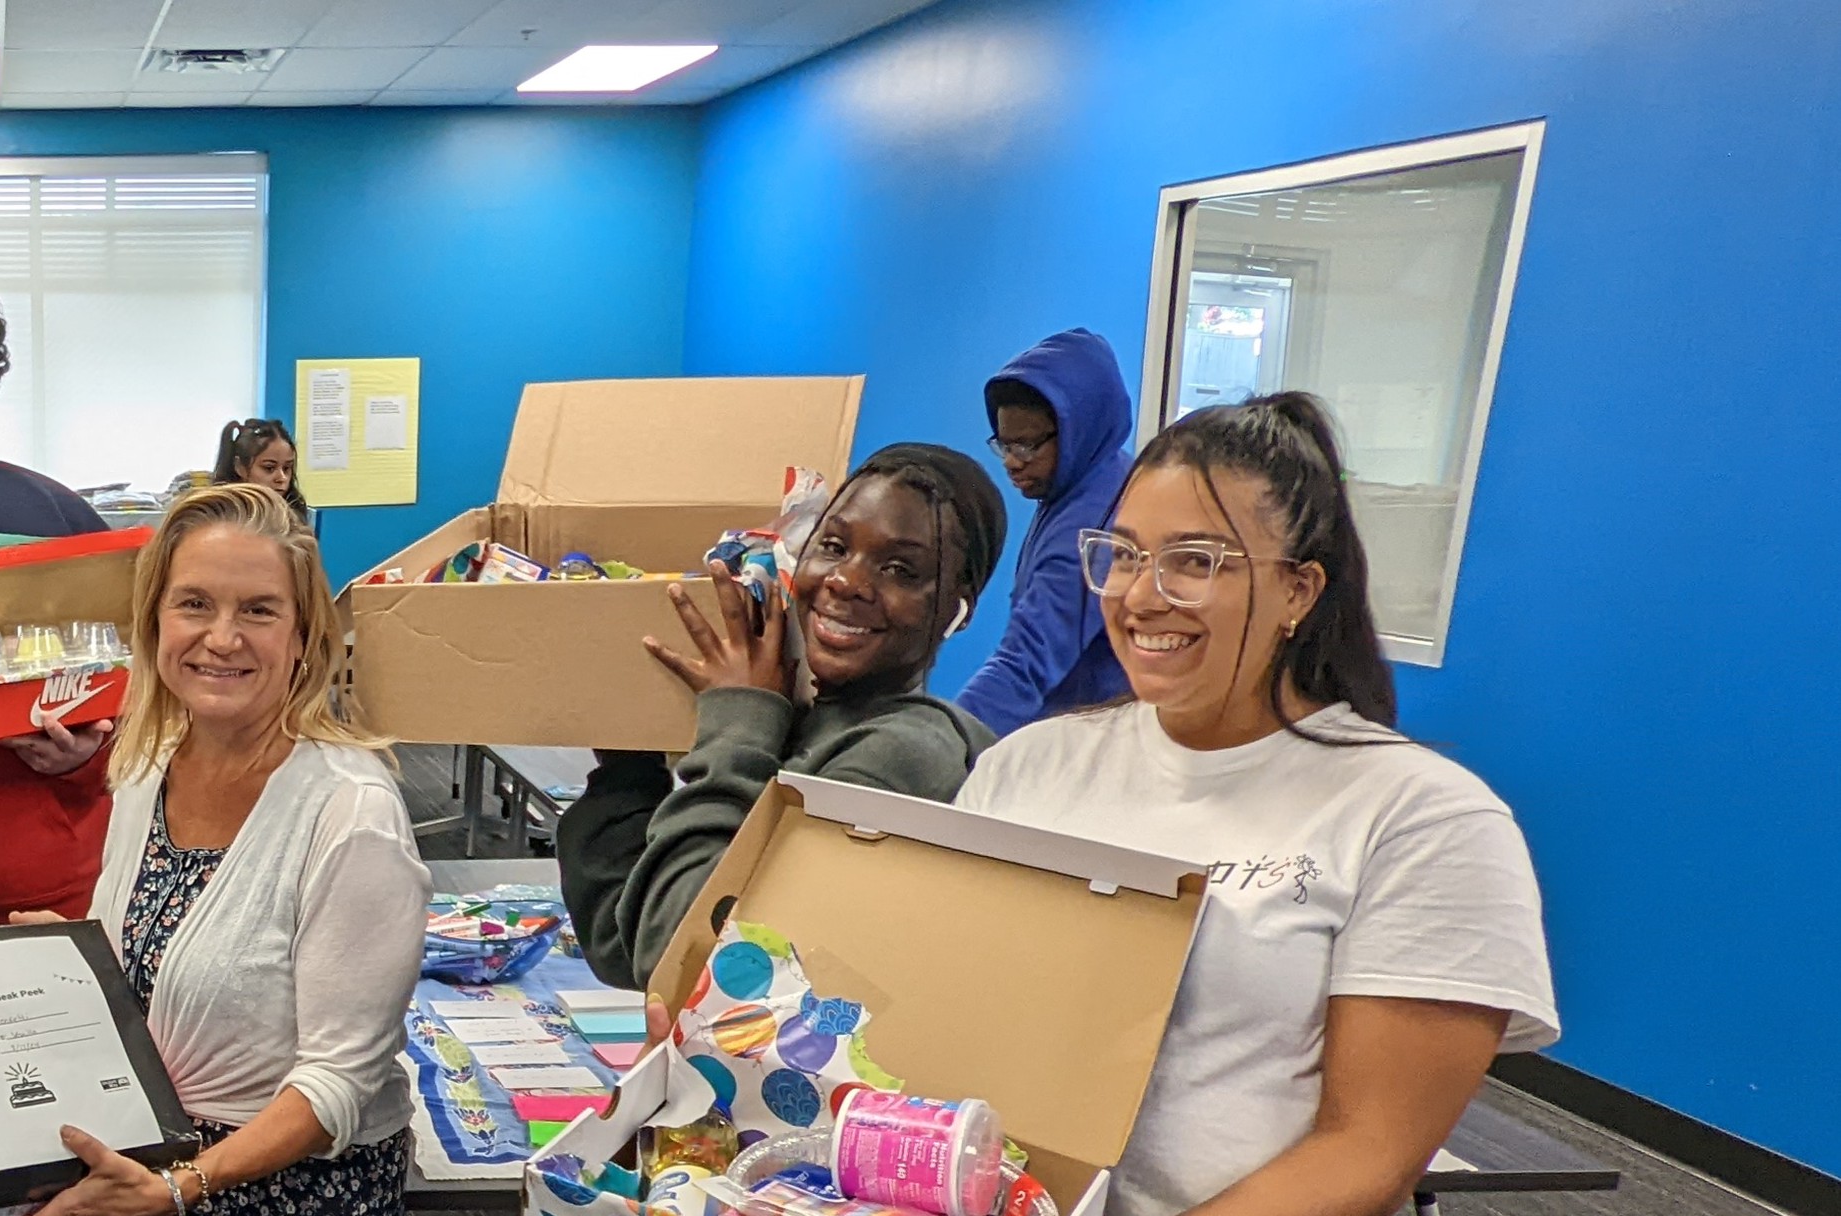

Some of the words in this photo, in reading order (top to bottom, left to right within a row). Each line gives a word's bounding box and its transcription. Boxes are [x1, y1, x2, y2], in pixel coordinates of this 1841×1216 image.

[41, 668, 95, 704] NIKE
[21, 987, 45, 997] Peek
[930, 1142, 940, 1168] Facts
[937, 1143, 949, 1186] Nutrition
